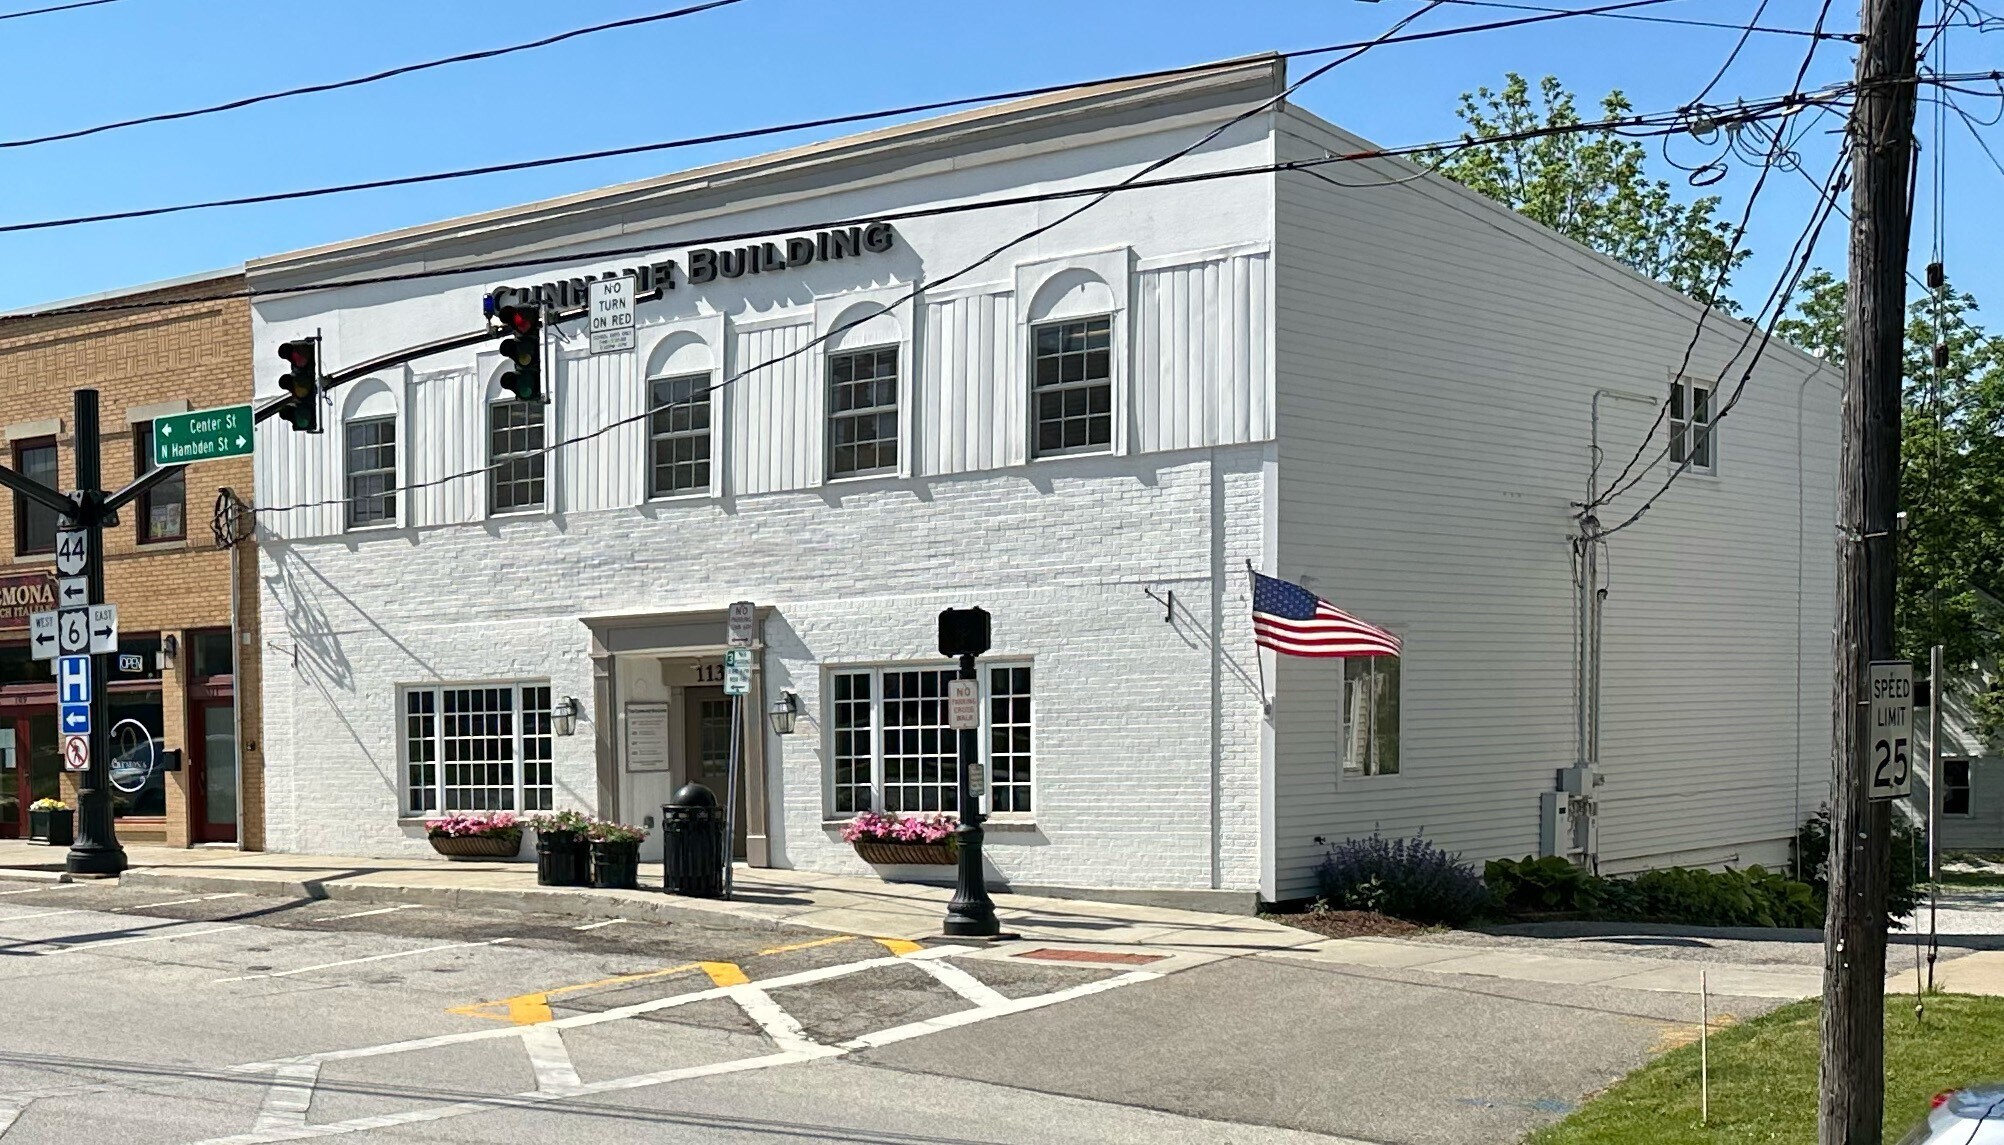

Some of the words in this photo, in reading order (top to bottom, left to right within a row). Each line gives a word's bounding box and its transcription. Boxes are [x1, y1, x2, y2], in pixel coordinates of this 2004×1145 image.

[491, 259, 676, 316] CUNNNE
[688, 221, 893, 284] BUILDING
[604, 282, 621, 295] NO
[599, 298, 626, 312] TURN
[593, 317, 607, 329] ON
[612, 313, 632, 326] RED
[190, 419, 221, 434] Center
[226, 413, 237, 429] St
[161, 445, 168, 458] N
[172, 441, 214, 457] Hambden
[218, 436, 229, 451] St
[59, 537, 85, 562] 44
[0, 584, 55, 605] MONA
[95, 609, 112, 621] EAST
[735, 607, 748, 615] NO
[36, 617, 53, 628] WEST
[69, 620, 80, 644] 6
[121, 657, 142, 669] OPEN
[728, 653, 734, 665] 3
[62, 659, 88, 701] H
[697, 664, 725, 682] 113
[957, 687, 970, 696] NO
[1874, 679, 1910, 698] SPEED
[1878, 706, 1906, 727] LIMIT
[1874, 738, 1907, 787] 25
